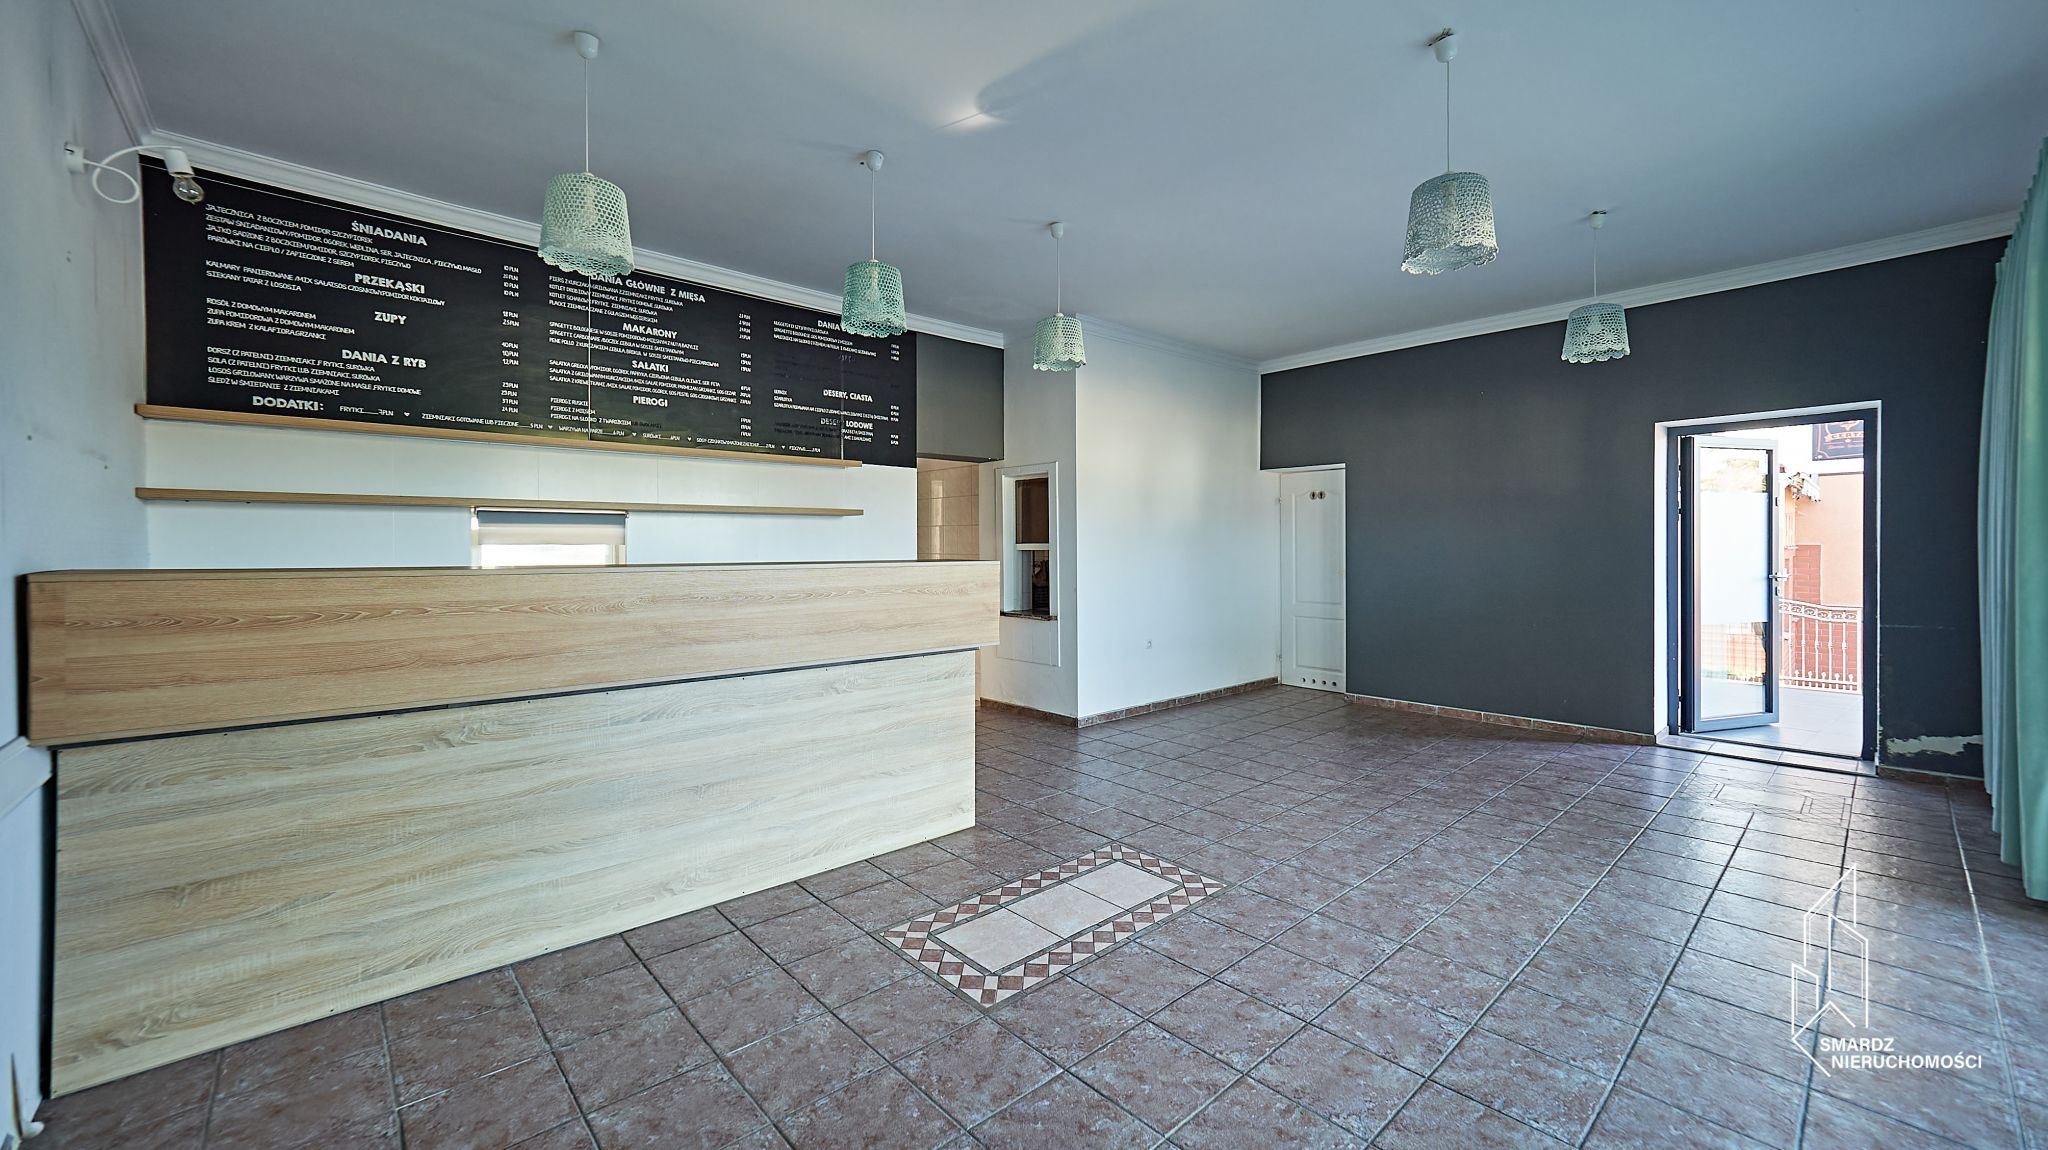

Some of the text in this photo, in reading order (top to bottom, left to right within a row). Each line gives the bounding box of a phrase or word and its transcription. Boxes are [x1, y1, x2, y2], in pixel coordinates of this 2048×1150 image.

[205, 214, 234, 225] ZESTAW
[262, 216, 298, 228] BOCZKIEM
[205, 225, 230, 234] JAJKO
[351, 221, 428, 246] ŚNIADANIA
[205, 260, 240, 270] KALMARY
[205, 271, 240, 280] SIEKANY
[354, 273, 425, 294] PRZEKĄSKI
[590, 274, 706, 303] DANIA GŁÓWNE Z MIĘSA
[225, 311, 273, 322] POMIDOROWA
[236, 303, 272, 312] DOMOWYM
[273, 308, 316, 319] MAKARONEM
[374, 311, 407, 325] ZUPY
[622, 323, 678, 339] MAKARONY
[817, 320, 840, 331] DANIA
[207, 347, 230, 355] DORSZ
[341, 349, 427, 368] DANIA Z RYB
[270, 364, 296, 372] FRYTKI
[631, 360, 669, 373] SAŁATKI
[632, 395, 668, 407] PIEROGI
[850, 392, 873, 403] CIASTA
[845, 420, 874, 430] LODOWE
